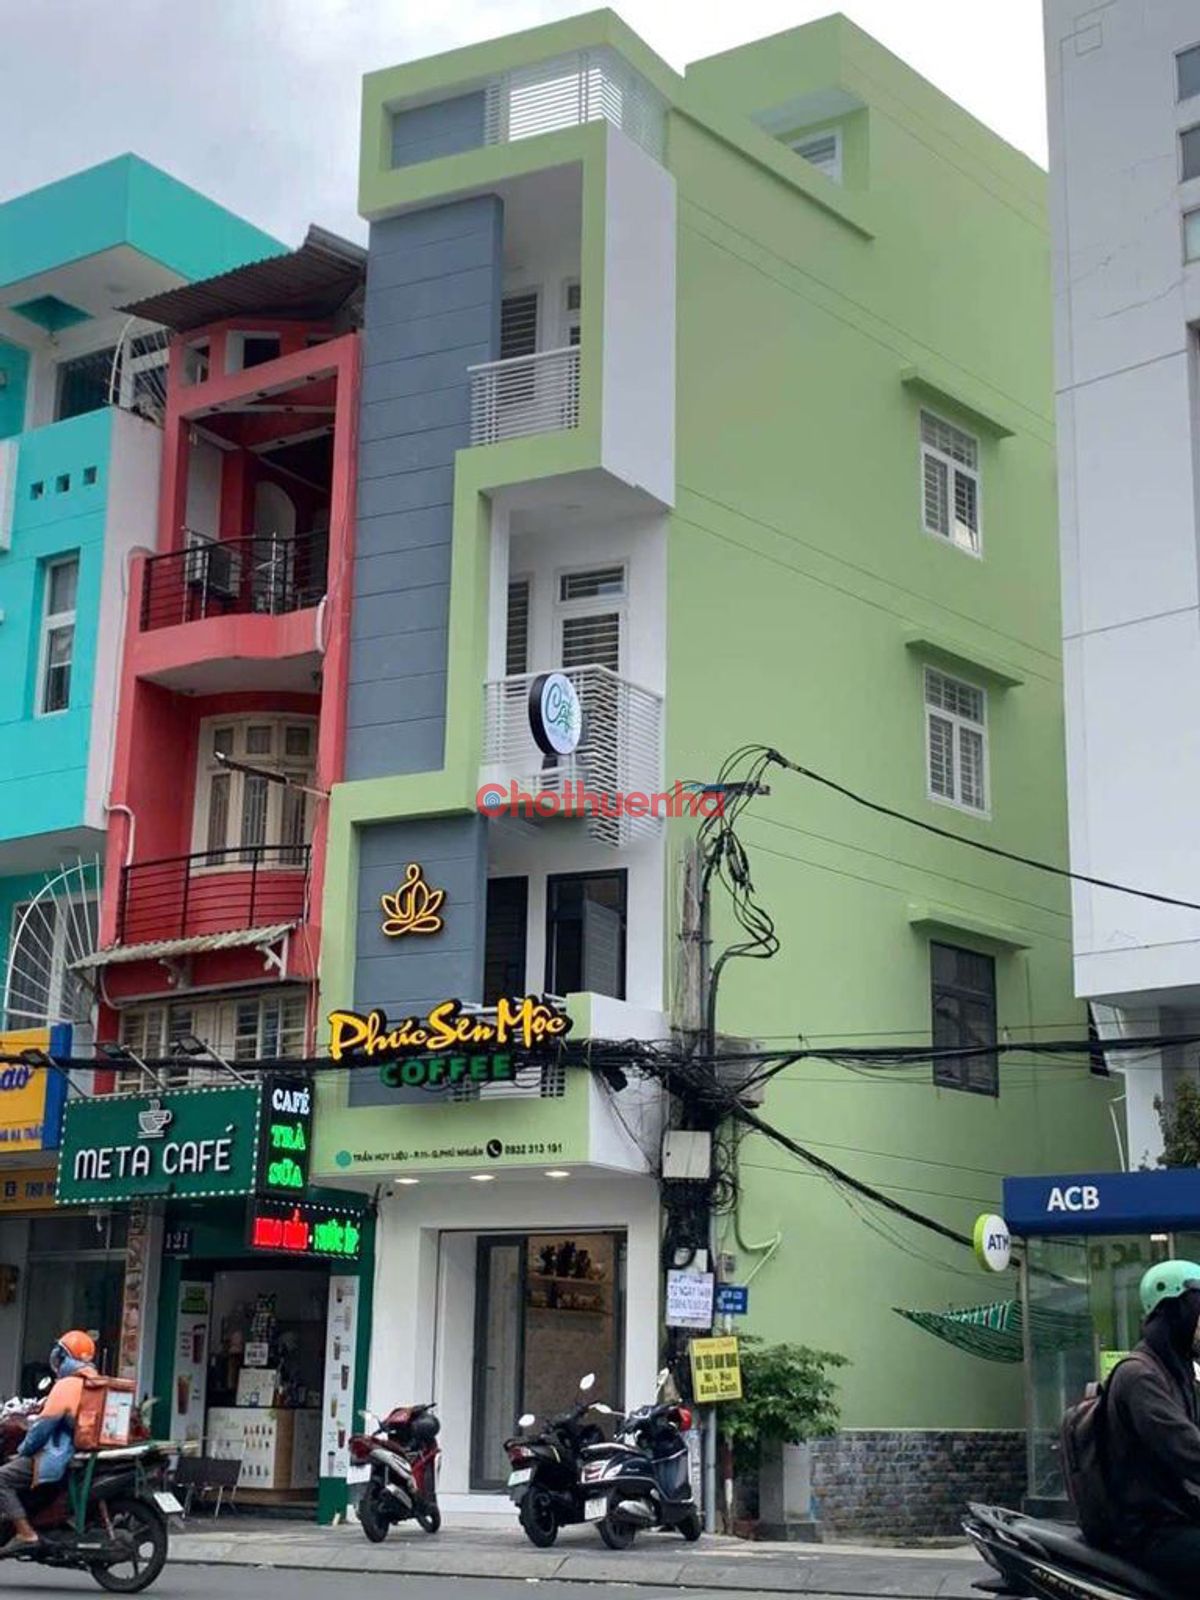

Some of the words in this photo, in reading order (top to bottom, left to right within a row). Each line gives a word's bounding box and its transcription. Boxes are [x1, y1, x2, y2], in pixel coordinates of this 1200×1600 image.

[328, 1011, 428, 1060] Phúc
[426, 1002, 495, 1049] Sen
[497, 998, 567, 1048] Mộc
[380, 1053, 511, 1087] COFFEE
[272, 1087, 310, 1115] CAFÉ
[270, 1122, 306, 1150] TRÀ
[74, 1145, 150, 1181] META
[162, 1123, 232, 1175] CAFÉ
[267, 1158, 304, 1188] SỮA
[1047, 1186, 1100, 1212] ACB
